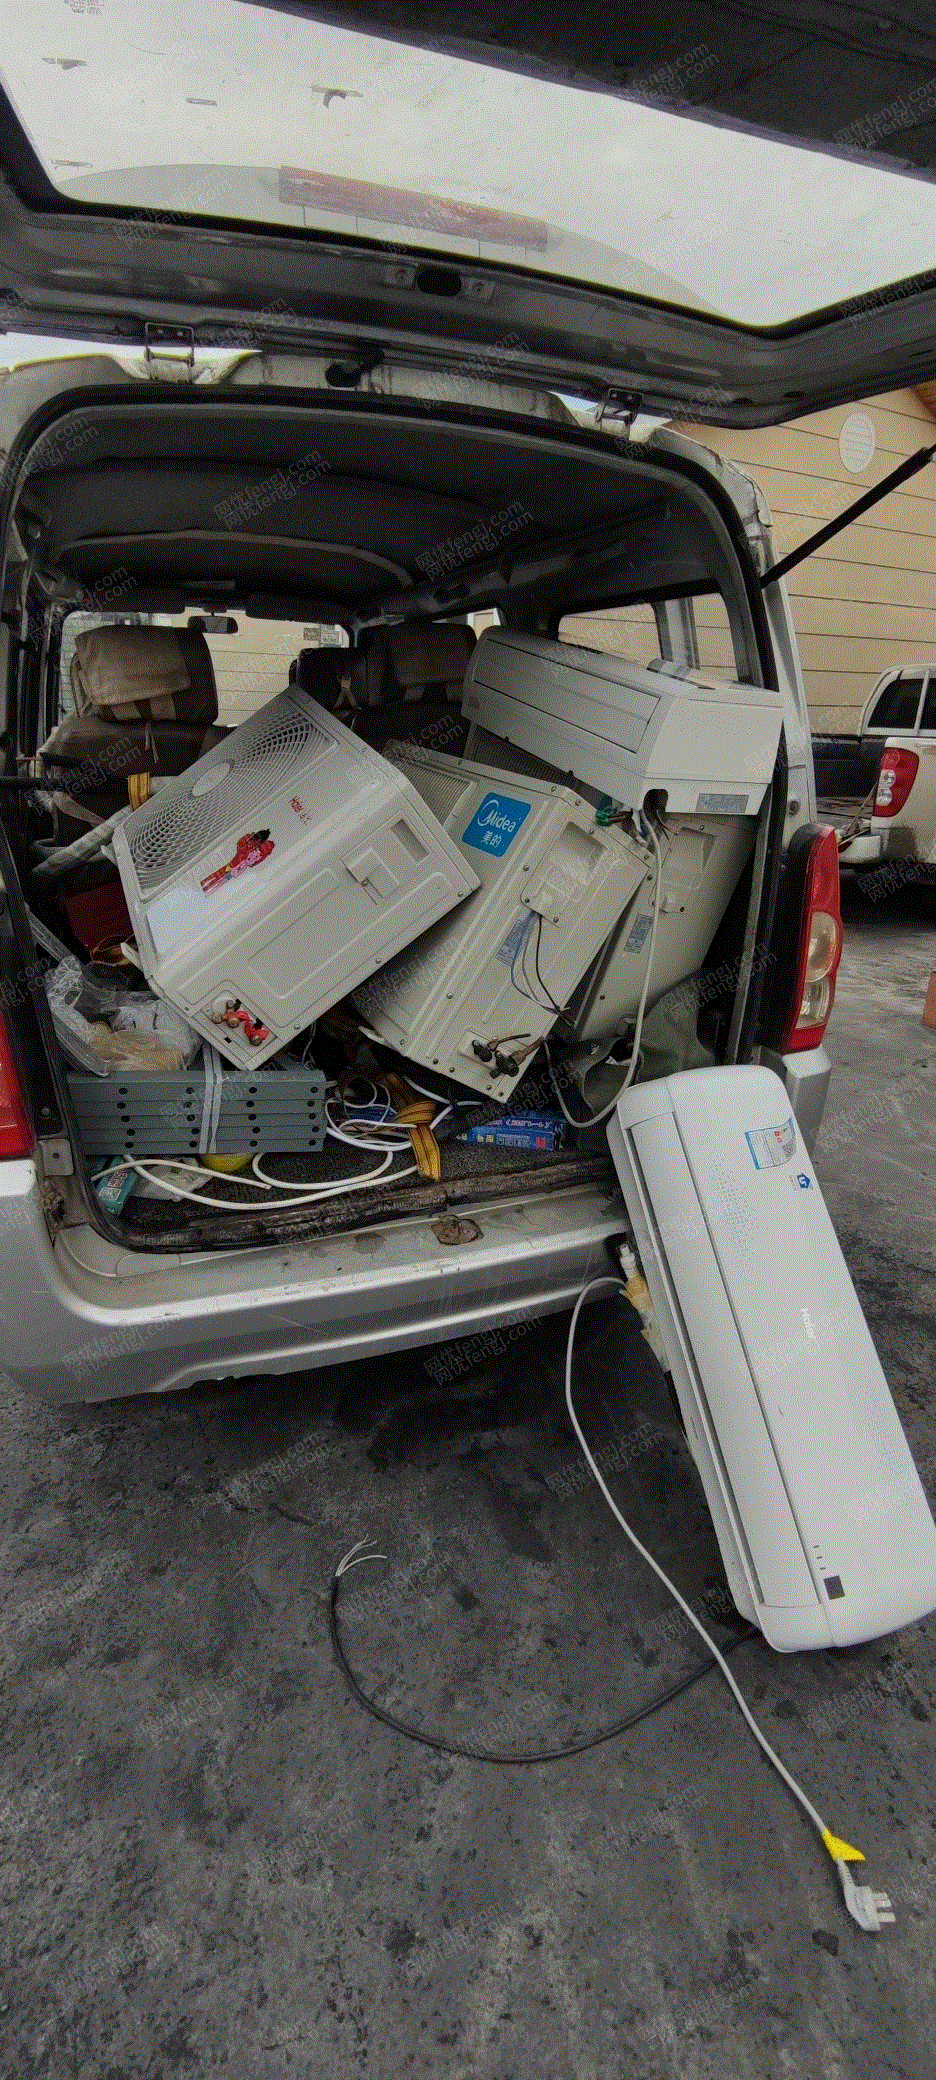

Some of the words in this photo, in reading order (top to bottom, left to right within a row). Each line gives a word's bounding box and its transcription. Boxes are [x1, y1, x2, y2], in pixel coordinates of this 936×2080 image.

[479, 804, 517, 833] Midea
[480, 830, 502, 848] 美的
[800, 1307, 816, 1339] Haier
